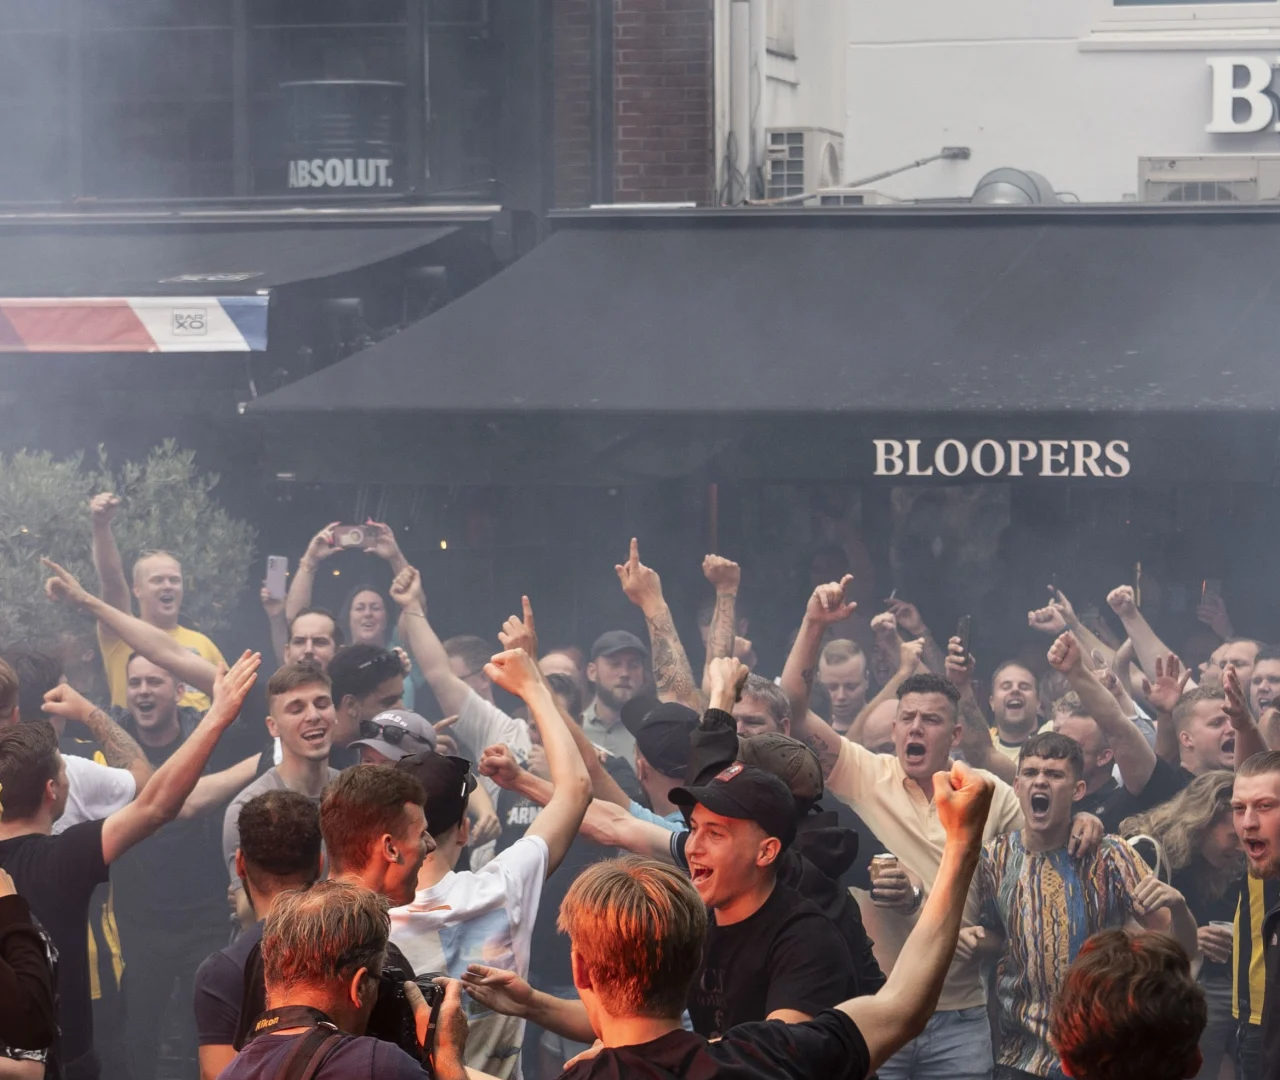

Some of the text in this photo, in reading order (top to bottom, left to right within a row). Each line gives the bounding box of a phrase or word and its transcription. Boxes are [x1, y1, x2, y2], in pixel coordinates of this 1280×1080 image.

[289, 158, 393, 188] ABSOLUT.
[174, 313, 204, 322] BAR
[175, 321, 204, 330] XO
[873, 439, 1131, 478] BLOOPERS
[255, 1016, 280, 1031] Nikon
